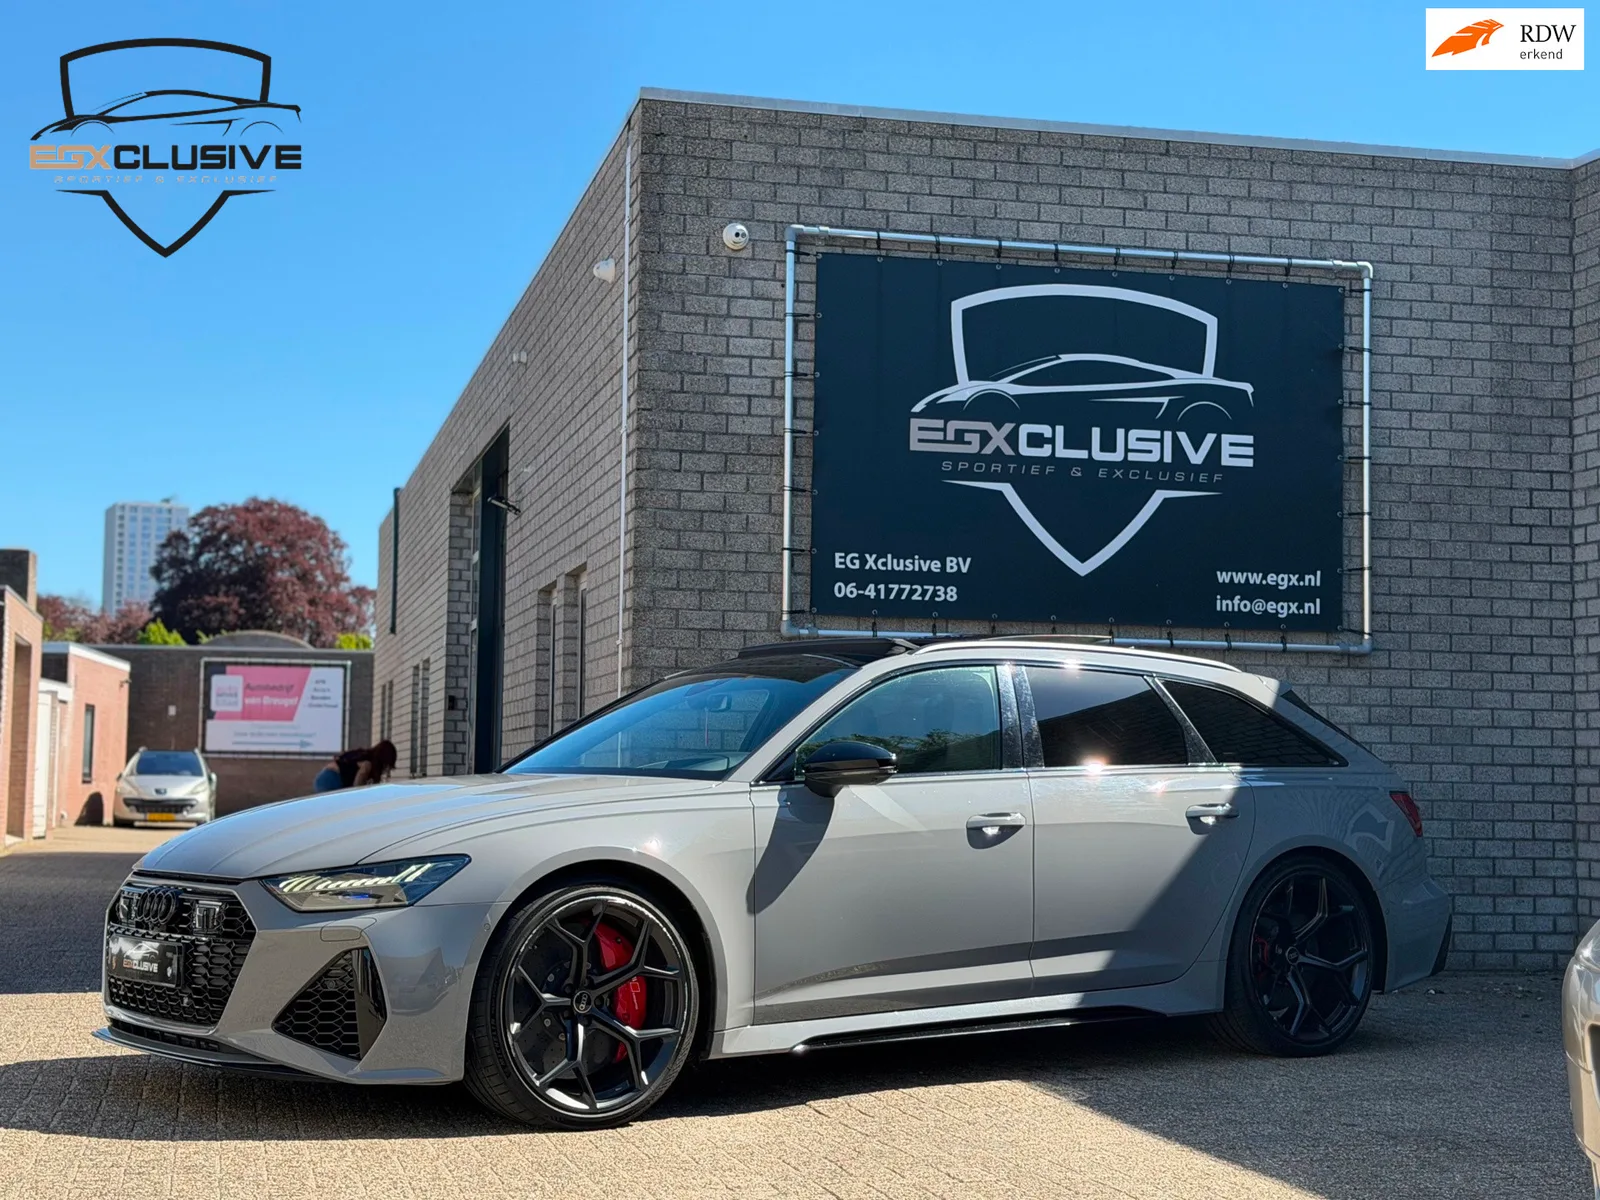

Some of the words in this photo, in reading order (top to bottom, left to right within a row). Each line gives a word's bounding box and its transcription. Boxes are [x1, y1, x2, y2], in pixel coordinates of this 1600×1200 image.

[941, 460, 1056, 476] SPORTIEF
[1070, 466, 1083, 477] &
[1098, 468, 1224, 484] EXCLUSIEF
[834, 552, 860, 570] EG
[864, 553, 942, 573] Xclusive
[945, 556, 972, 573] BV
[1216, 570, 1321, 590] www.egx.nl
[833, 581, 958, 602] 06-41772738
[1216, 595, 1321, 618] info@egx.nl
